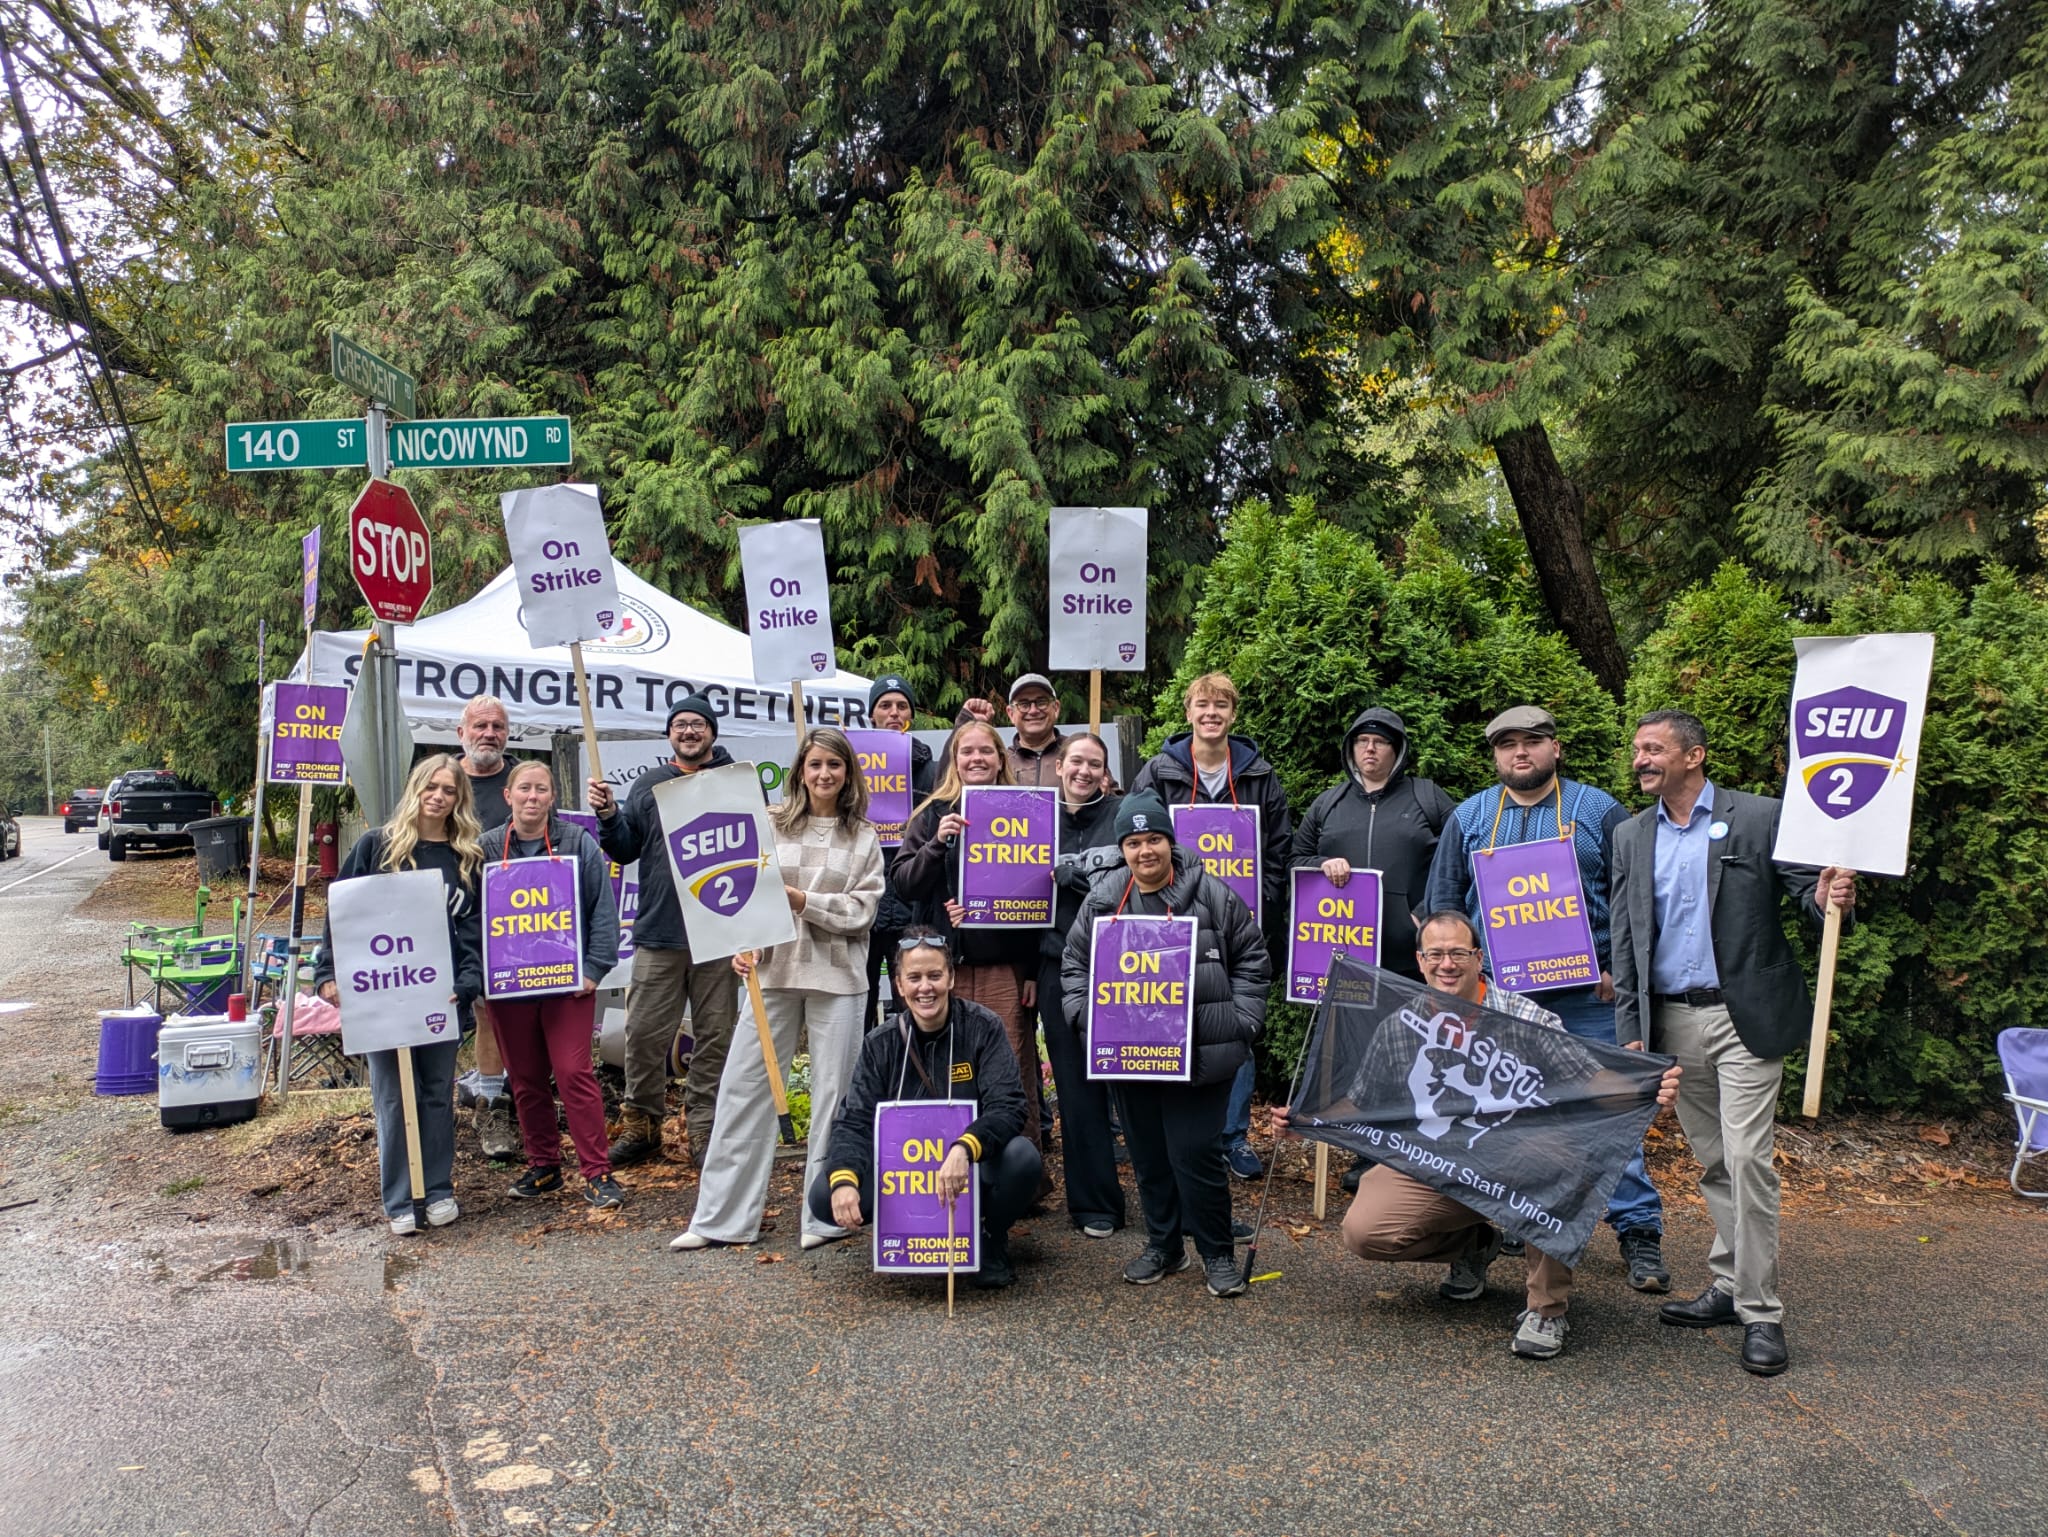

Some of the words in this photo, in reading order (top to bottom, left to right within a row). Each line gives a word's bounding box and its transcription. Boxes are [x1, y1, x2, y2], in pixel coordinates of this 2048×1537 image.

[338, 341, 397, 404] CRESCENT
[404, 382, 412, 400] RD
[238, 428, 299, 463] 140
[337, 428, 355, 447] ST
[398, 427, 528, 460] NICOWYND
[546, 428, 561, 444] RD
[357, 517, 426, 583] STOP
[543, 538, 580, 561] On
[531, 569, 602, 593] Strike
[1080, 563, 1115, 583] On
[770, 577, 800, 597] On
[1063, 594, 1132, 614] Strike
[760, 607, 817, 630] Strike
[296, 704, 325, 720] ON
[1805, 707, 1894, 739] SEIU
[296, 763, 339, 771] STRONGER
[864, 775, 907, 792] RIKE
[1827, 768, 1854, 805] 2
[990, 817, 1028, 838] ON
[680, 821, 746, 861] SEIU
[1198, 833, 1233, 852] ON
[968, 844, 1050, 865] STRIKE
[1202, 858, 1254, 877] RIKE
[714, 875, 738, 907] 2
[1508, 873, 1549, 897] ON
[510, 887, 548, 909] ON
[993, 899, 1048, 910] STRONGER
[1318, 898, 1354, 919] ON
[974, 912, 980, 920] 2
[994, 911, 1046, 921] TOGETHER
[1490, 895, 1580, 929] STRIKE
[490, 911, 572, 937] STRIKE
[1297, 922, 1374, 946] STRIKE
[370, 934, 414, 956] On
[618, 929, 633, 950] 2
[494, 971, 511, 979] SEIU
[517, 964, 574, 978] STRONGER
[1119, 951, 1160, 973] ON
[1502, 965, 1520, 974] SEIU
[1528, 954, 1591, 972] STRONGER
[353, 965, 437, 993] Strike
[519, 976, 573, 988] TOGETHER
[1510, 978, 1516, 986] 2
[1530, 968, 1591, 984] TOGETHER
[1096, 982, 1183, 1005] STRIKE
[428, 1014, 445, 1024] SEIU
[1096, 1047, 1114, 1055] SEIU
[1121, 1046, 1181, 1058] STRONGER
[1102, 1061, 1108, 1070] 2
[1121, 1059, 1180, 1072] TOGETHER
[902, 1138, 943, 1163] ON
[881, 1170, 969, 1195] STRI
[1387, 1132, 1456, 1177] Support
[1458, 1168, 1507, 1199] Staff
[1510, 1191, 1562, 1234] Union
[883, 1239, 900, 1247] SEIU
[889, 1253, 895, 1262] 2
